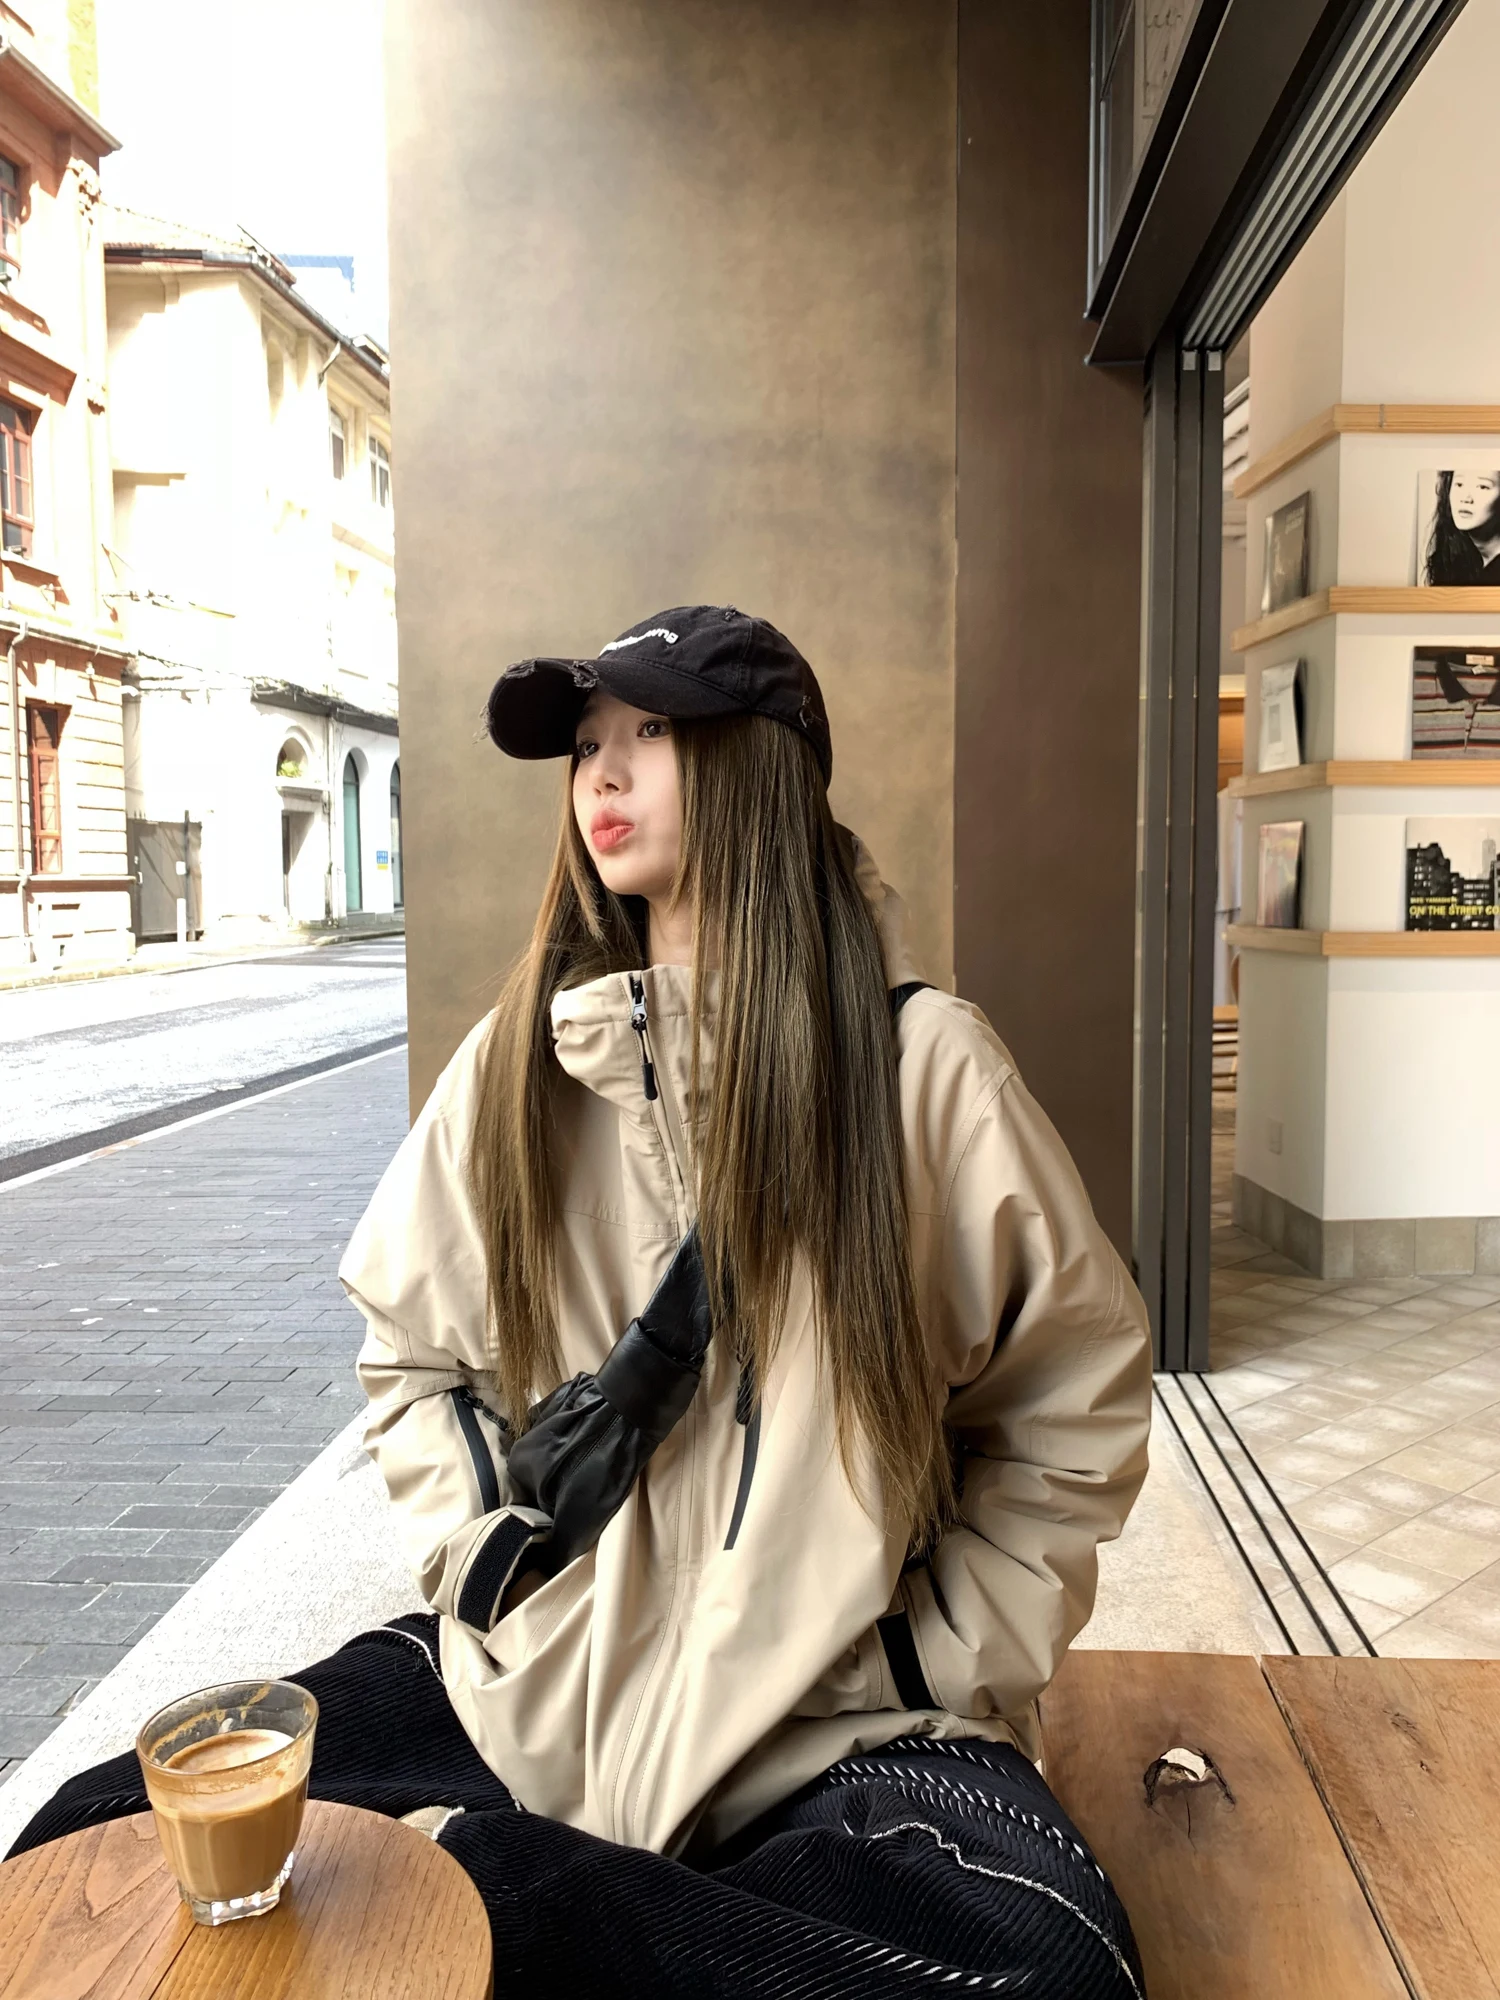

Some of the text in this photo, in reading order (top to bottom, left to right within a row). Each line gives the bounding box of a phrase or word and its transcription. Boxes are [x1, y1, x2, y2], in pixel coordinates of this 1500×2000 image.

[1409, 905, 1425, 916] ON
[1428, 905, 1446, 916] THE
[1448, 905, 1483, 916] STREET
